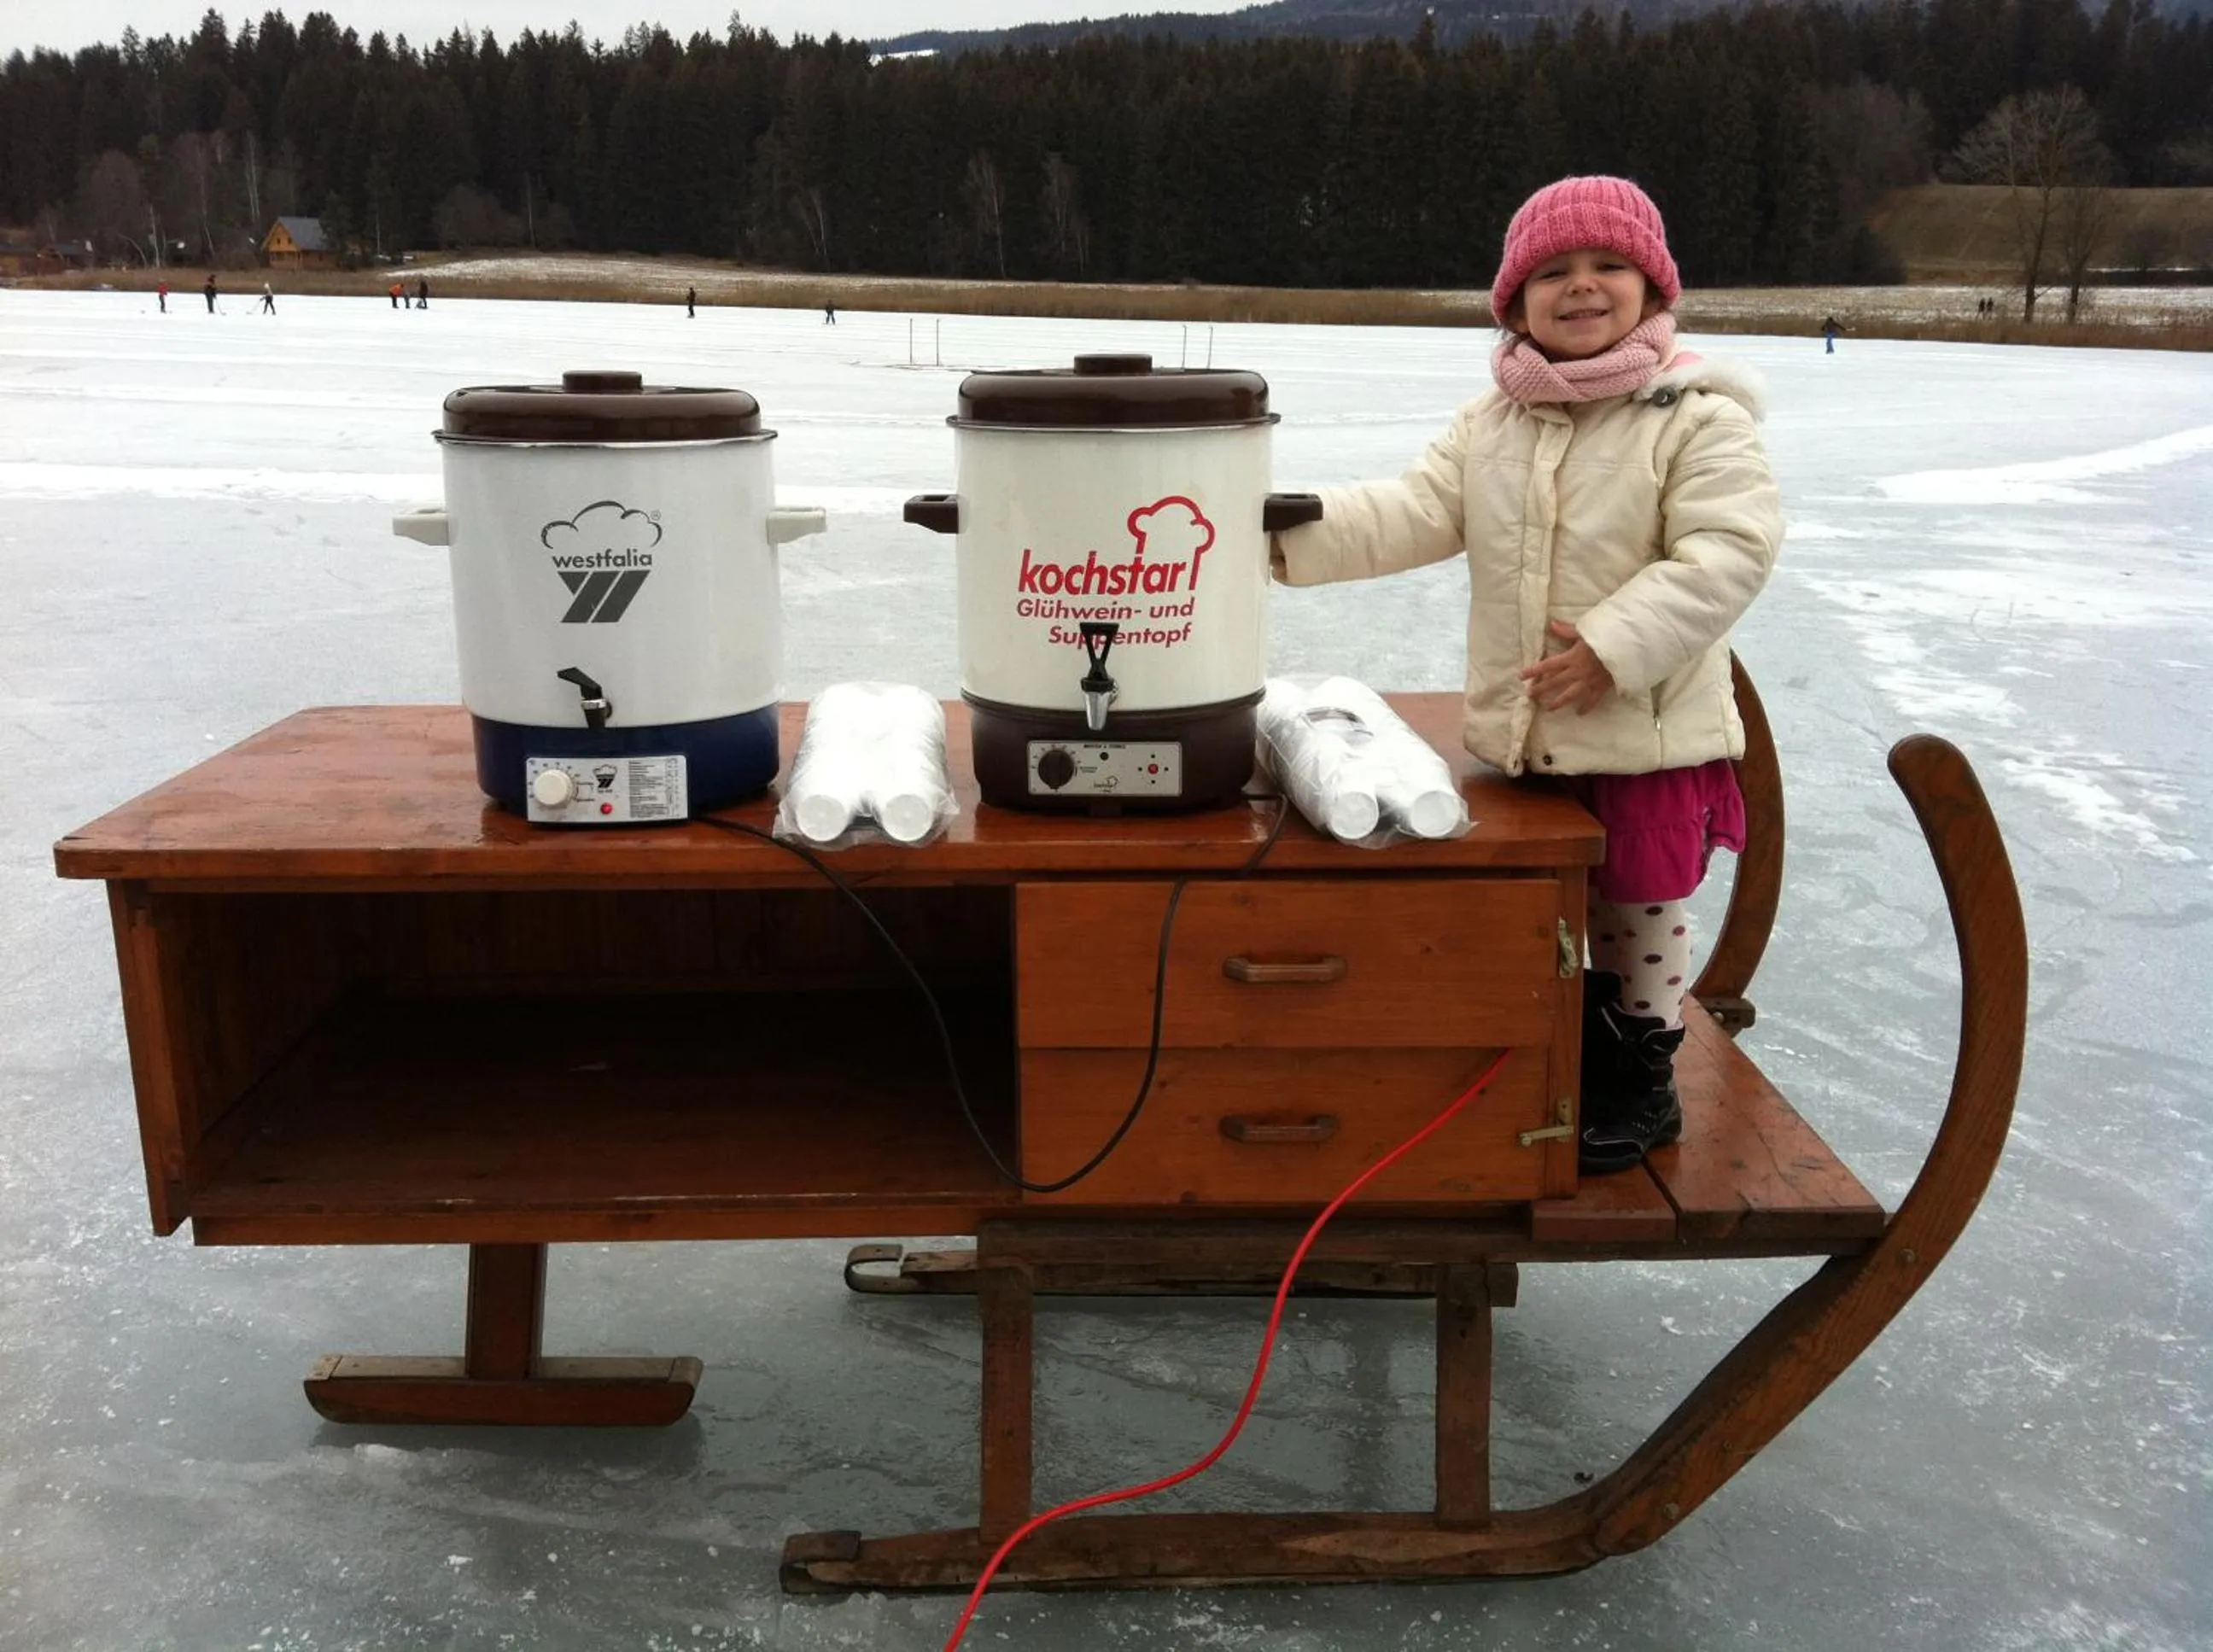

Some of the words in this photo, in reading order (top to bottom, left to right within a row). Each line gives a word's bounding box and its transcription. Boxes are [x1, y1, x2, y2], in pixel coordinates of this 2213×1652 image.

[552, 548, 652, 568] westfalia
[1018, 549, 1187, 595] kochstar
[1016, 598, 1142, 620] Glühwein-
[1149, 596, 1195, 618] und
